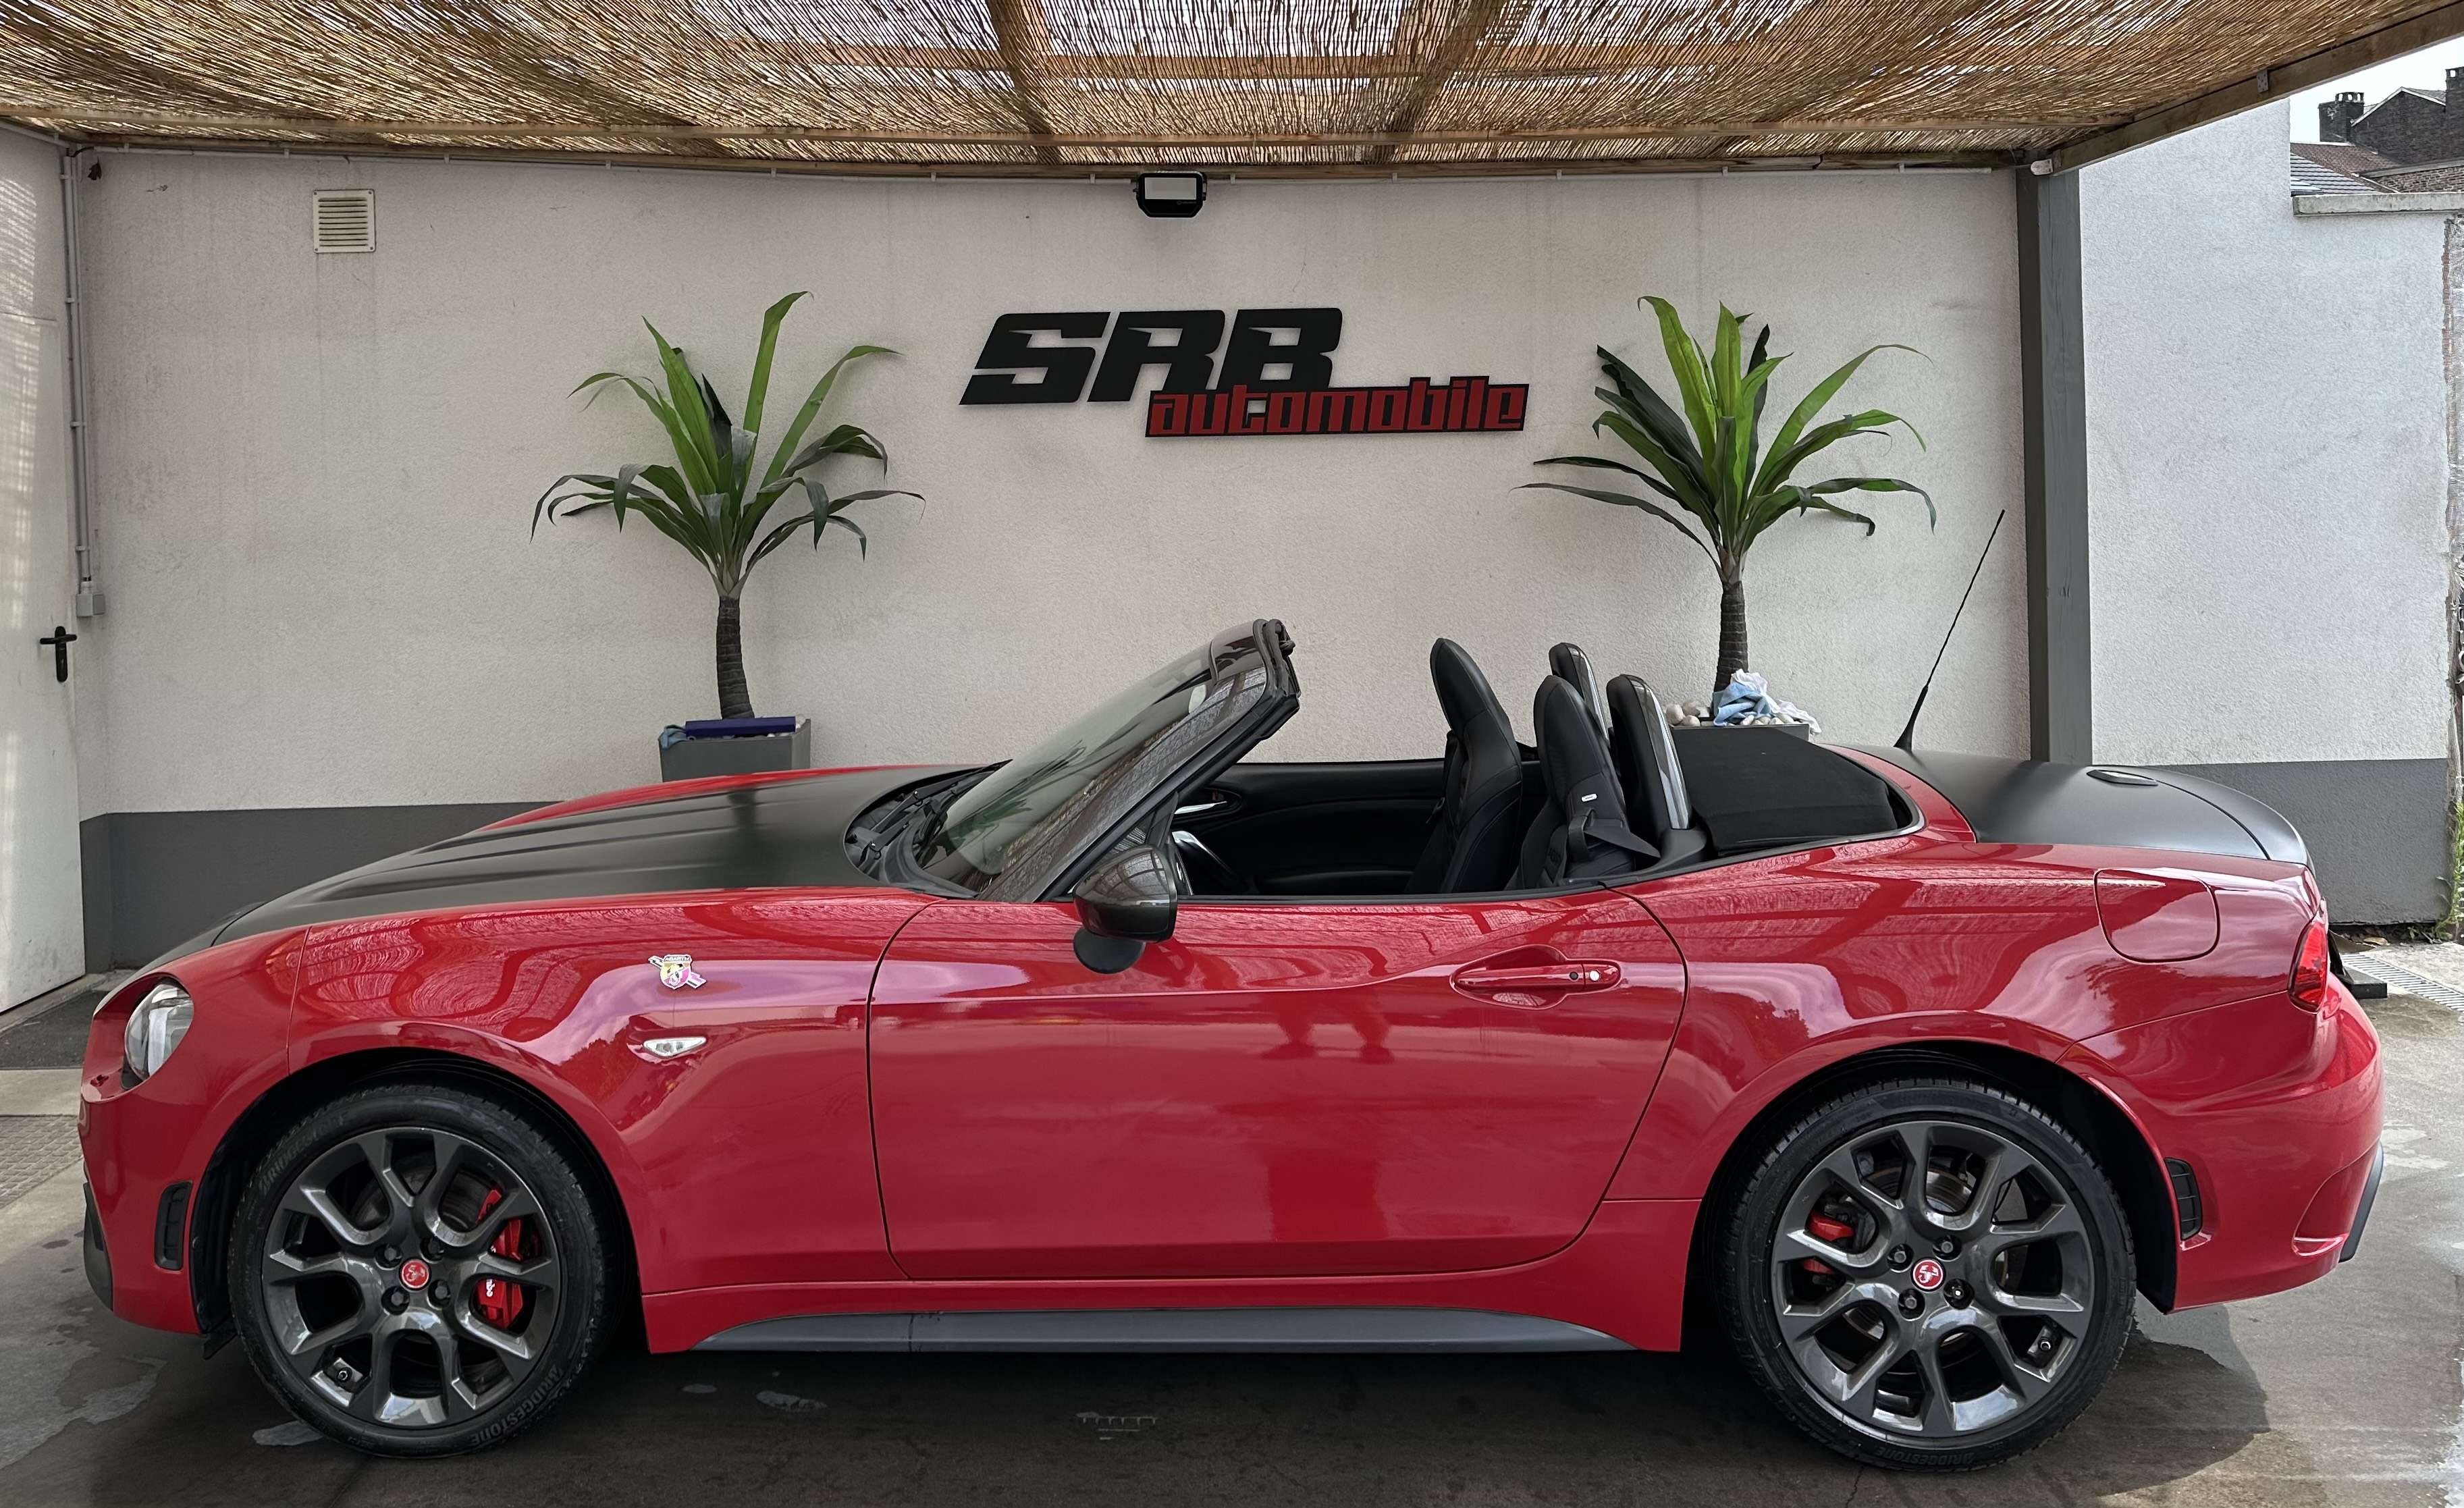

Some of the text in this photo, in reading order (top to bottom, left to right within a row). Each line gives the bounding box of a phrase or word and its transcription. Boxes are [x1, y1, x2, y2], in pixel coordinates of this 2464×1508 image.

[959, 308, 1343, 405] SRB
[1148, 376, 1526, 436] automobile
[470, 1363, 565, 1446] BRIDGESTONE
[1874, 1447, 1977, 1465] BRIDGESTONE
